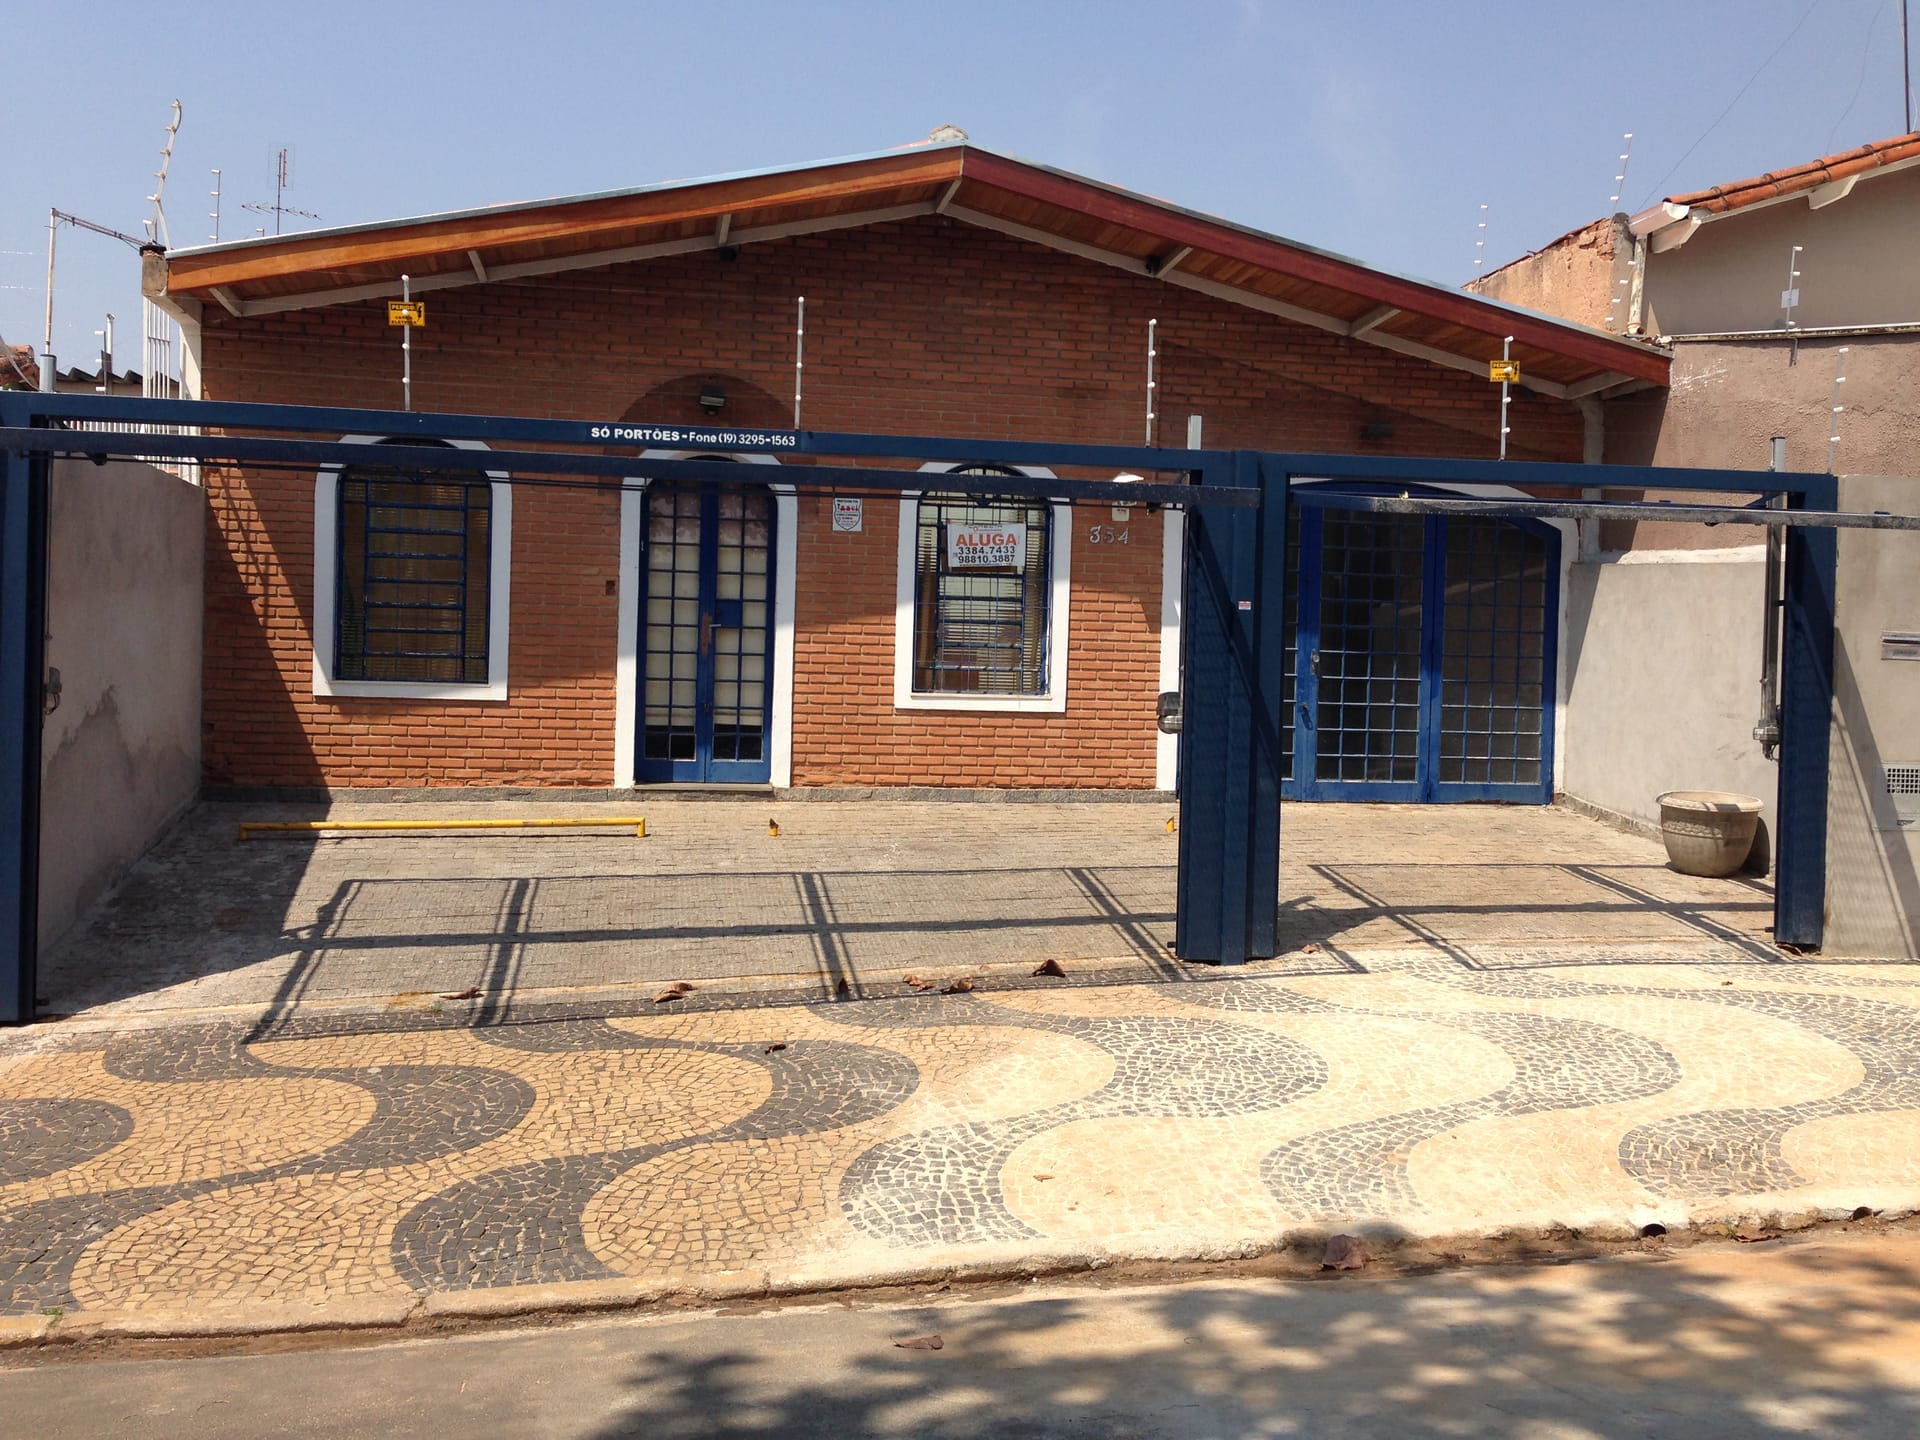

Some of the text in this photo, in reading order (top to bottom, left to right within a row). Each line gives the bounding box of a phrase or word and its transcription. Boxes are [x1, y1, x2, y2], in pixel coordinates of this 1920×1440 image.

[591, 426, 610, 438] SÓ
[614, 428, 680, 441] PORTÕES
[689, 432, 717, 443] Fone
[718, 433, 737, 444] (19)
[738, 434, 796, 446] 3295-1563
[956, 533, 1017, 546] ALUGA
[958, 546, 1016, 555] 3384.7433
